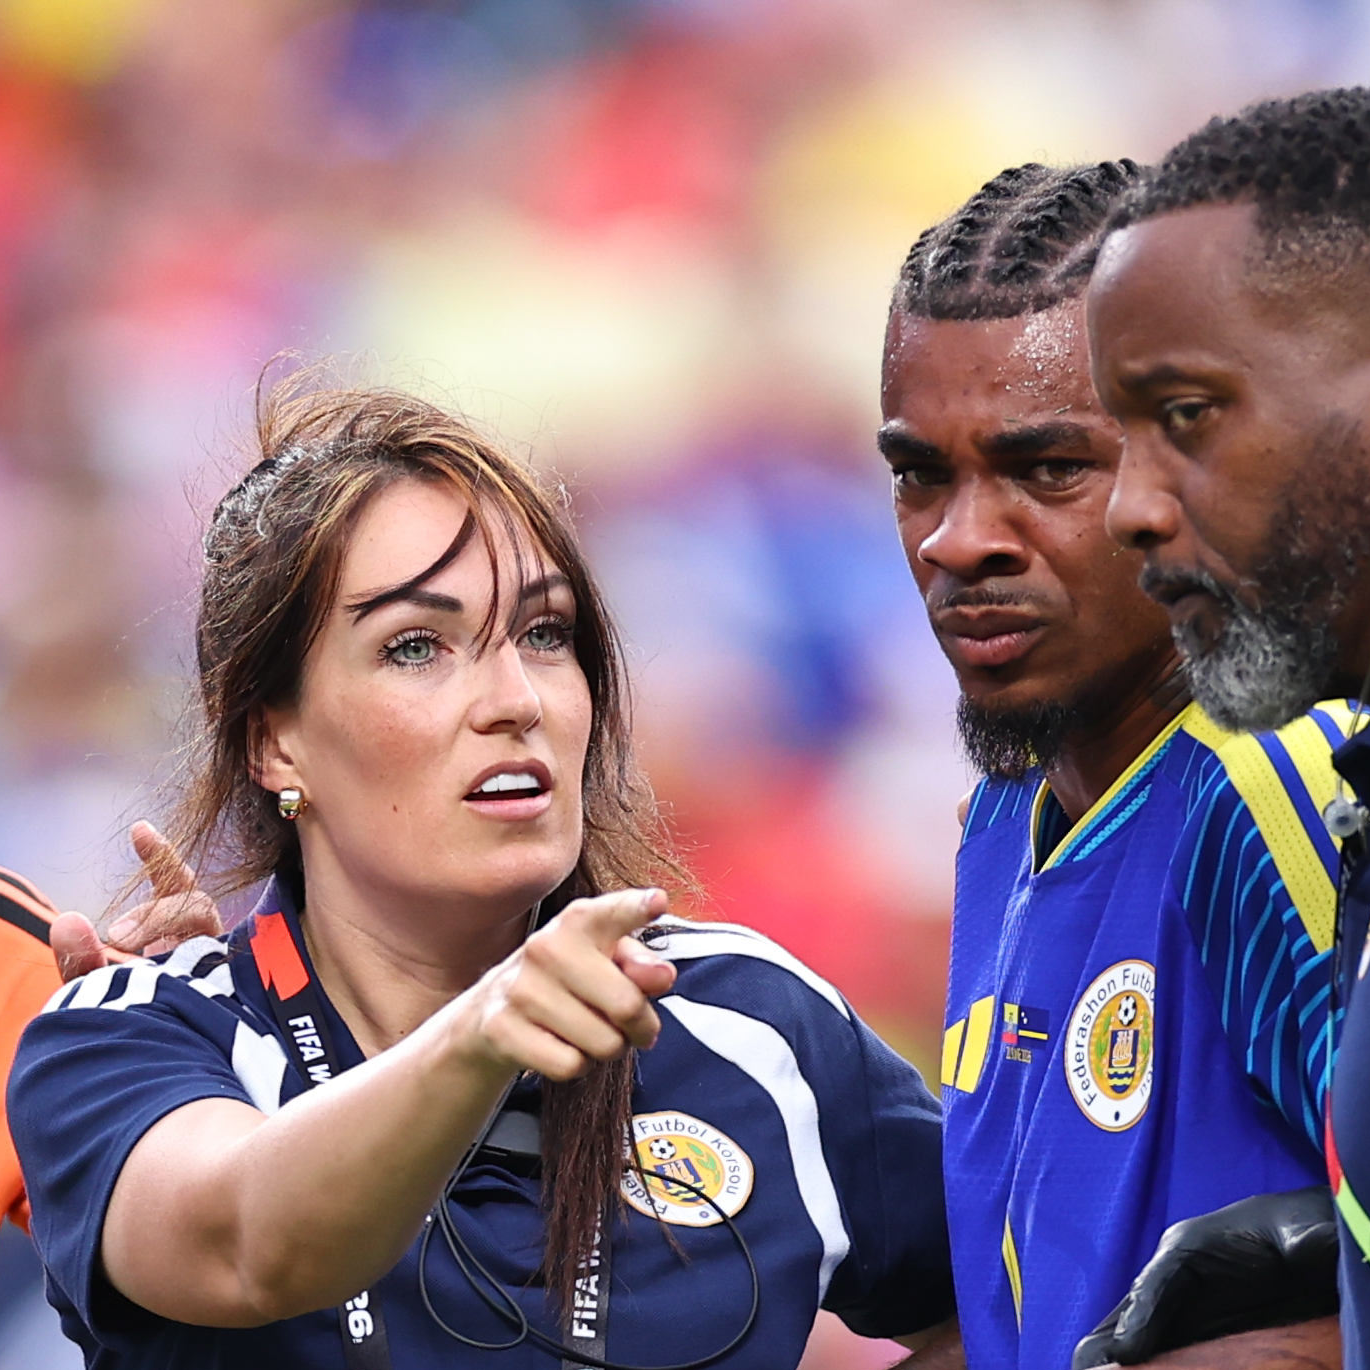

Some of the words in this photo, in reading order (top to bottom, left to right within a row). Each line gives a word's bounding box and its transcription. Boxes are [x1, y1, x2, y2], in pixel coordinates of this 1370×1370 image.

[288, 1014, 326, 1062] FIFA
[1072, 978, 1117, 1108] Federashon
[638, 1118, 708, 1138] Futbòl
[710, 1137, 742, 1196] Kòrsou
[345, 1290, 374, 1338] 26
